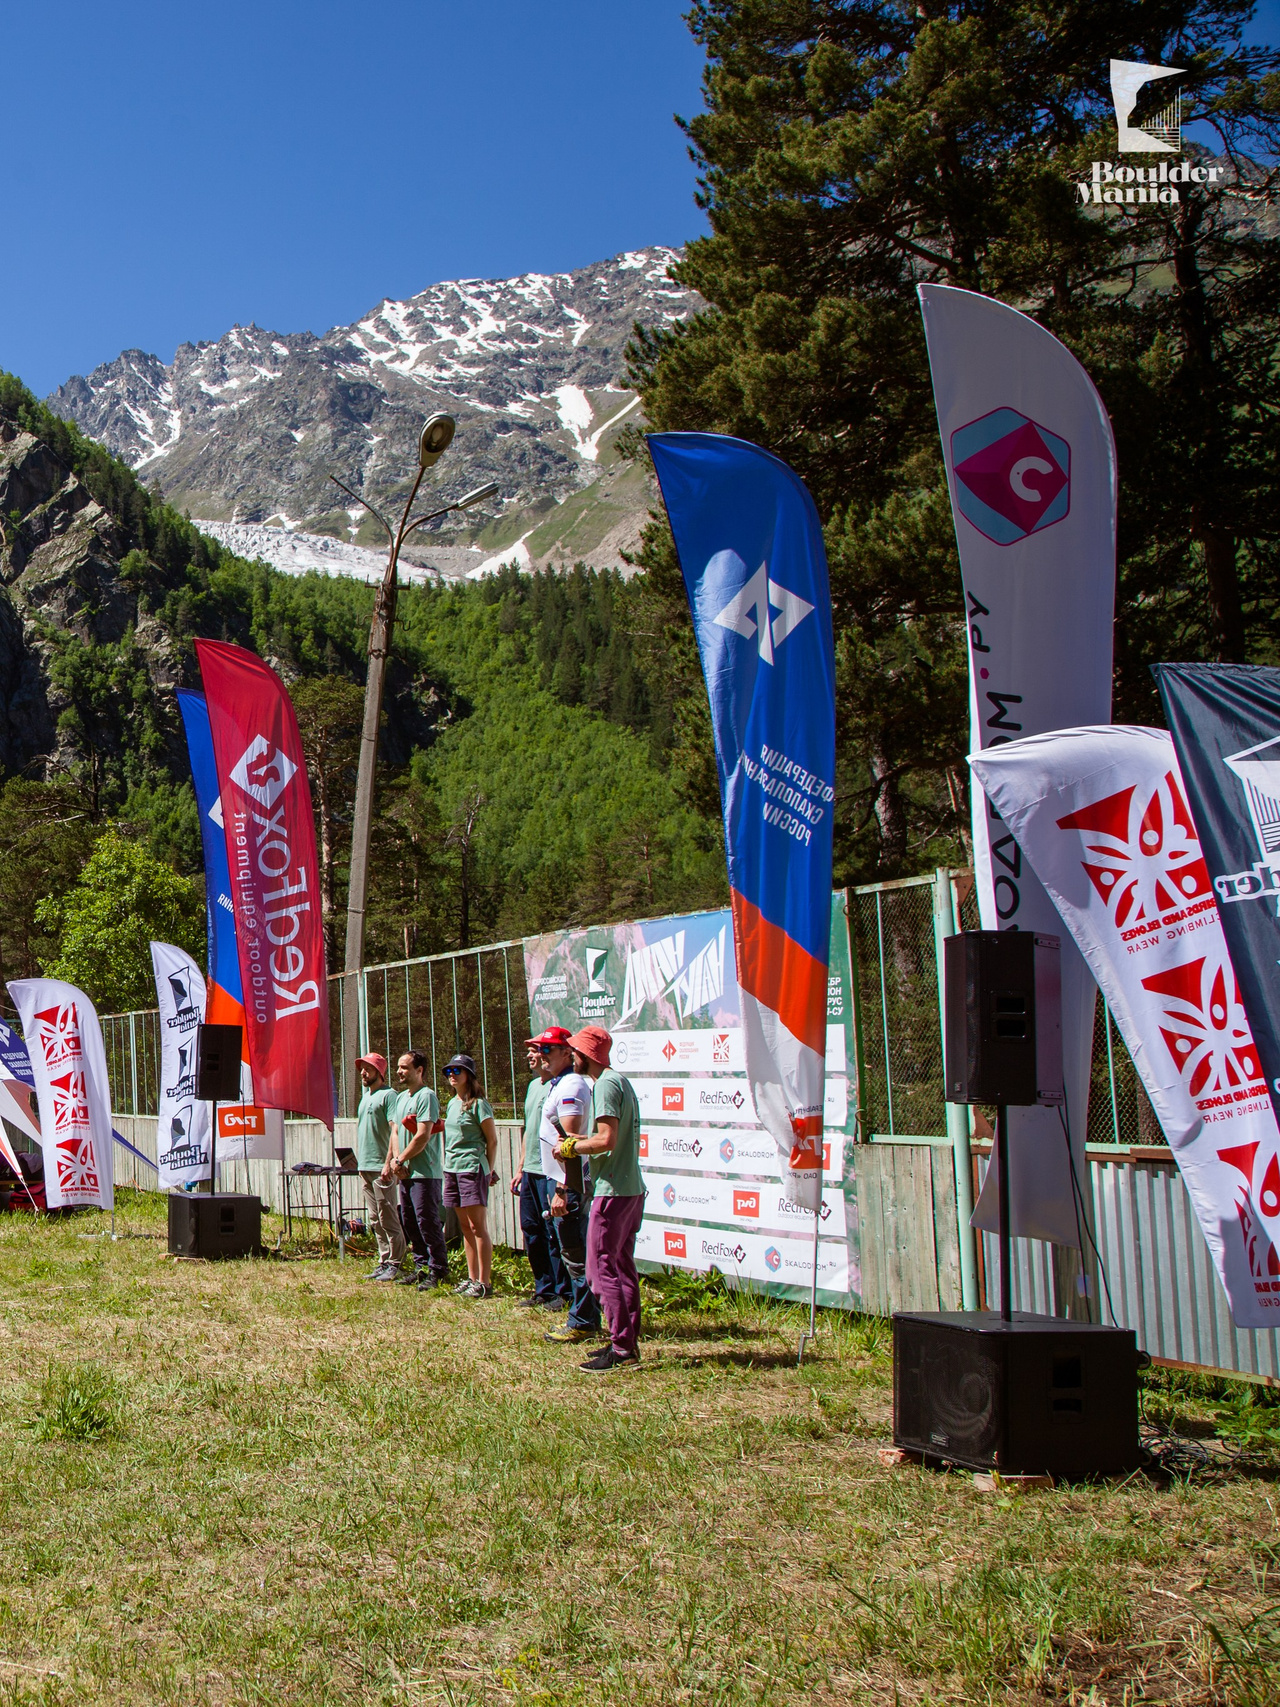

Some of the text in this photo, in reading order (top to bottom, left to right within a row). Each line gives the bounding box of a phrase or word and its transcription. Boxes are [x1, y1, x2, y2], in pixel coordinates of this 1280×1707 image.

[582, 994, 616, 1008] Boulder
[579, 1005, 605, 1018] Mania
[699, 1090, 734, 1105] RedFox
[662, 1138, 693, 1153] RedFox
[701, 1240, 735, 1257] RedFox
